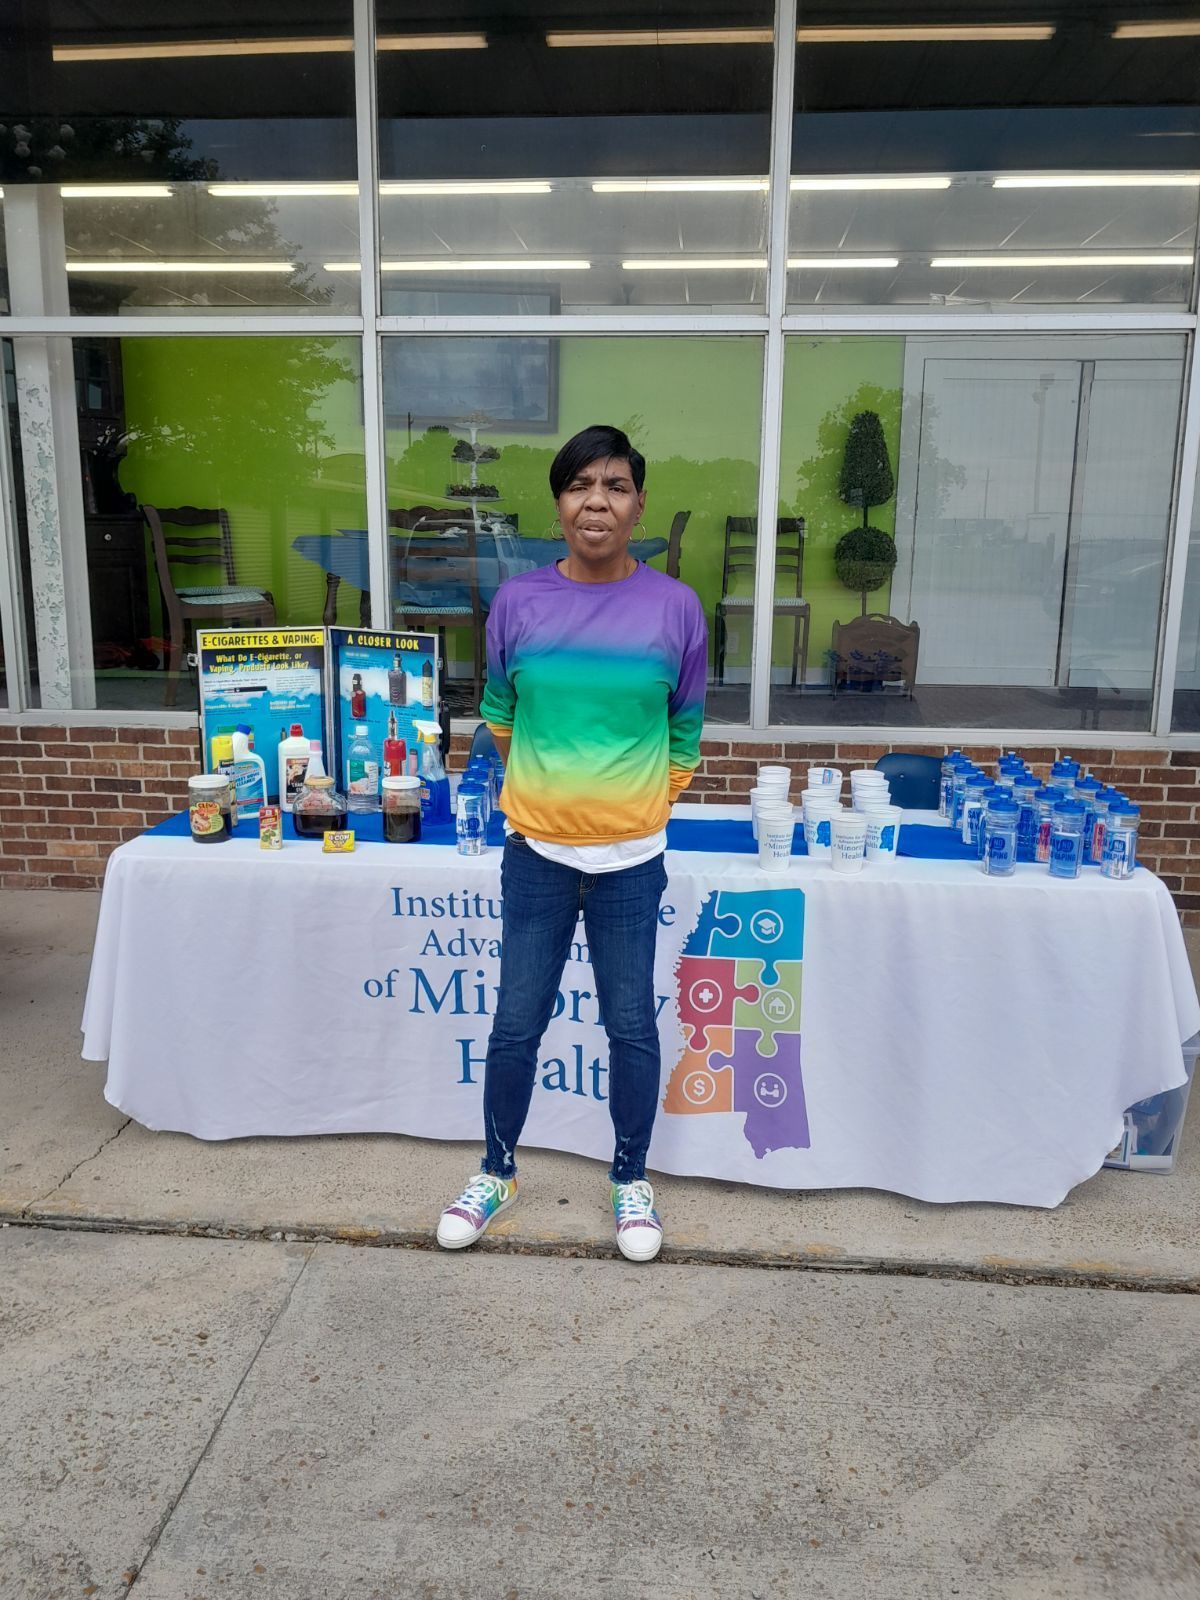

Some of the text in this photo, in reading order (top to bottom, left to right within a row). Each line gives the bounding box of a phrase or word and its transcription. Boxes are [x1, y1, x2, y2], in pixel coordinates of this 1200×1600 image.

[202, 634, 320, 647] E-CIGARETTES & VAPING:
[347, 634, 419, 650] A CLOSER LOOK
[215, 653, 235, 663] What
[238, 653, 248, 662] Do
[272, 661, 289, 670] Look
[291, 661, 310, 670] Like?
[390, 887, 504, 920] Institu
[363, 968, 400, 998] of
[455, 1038, 609, 1101] Halt
